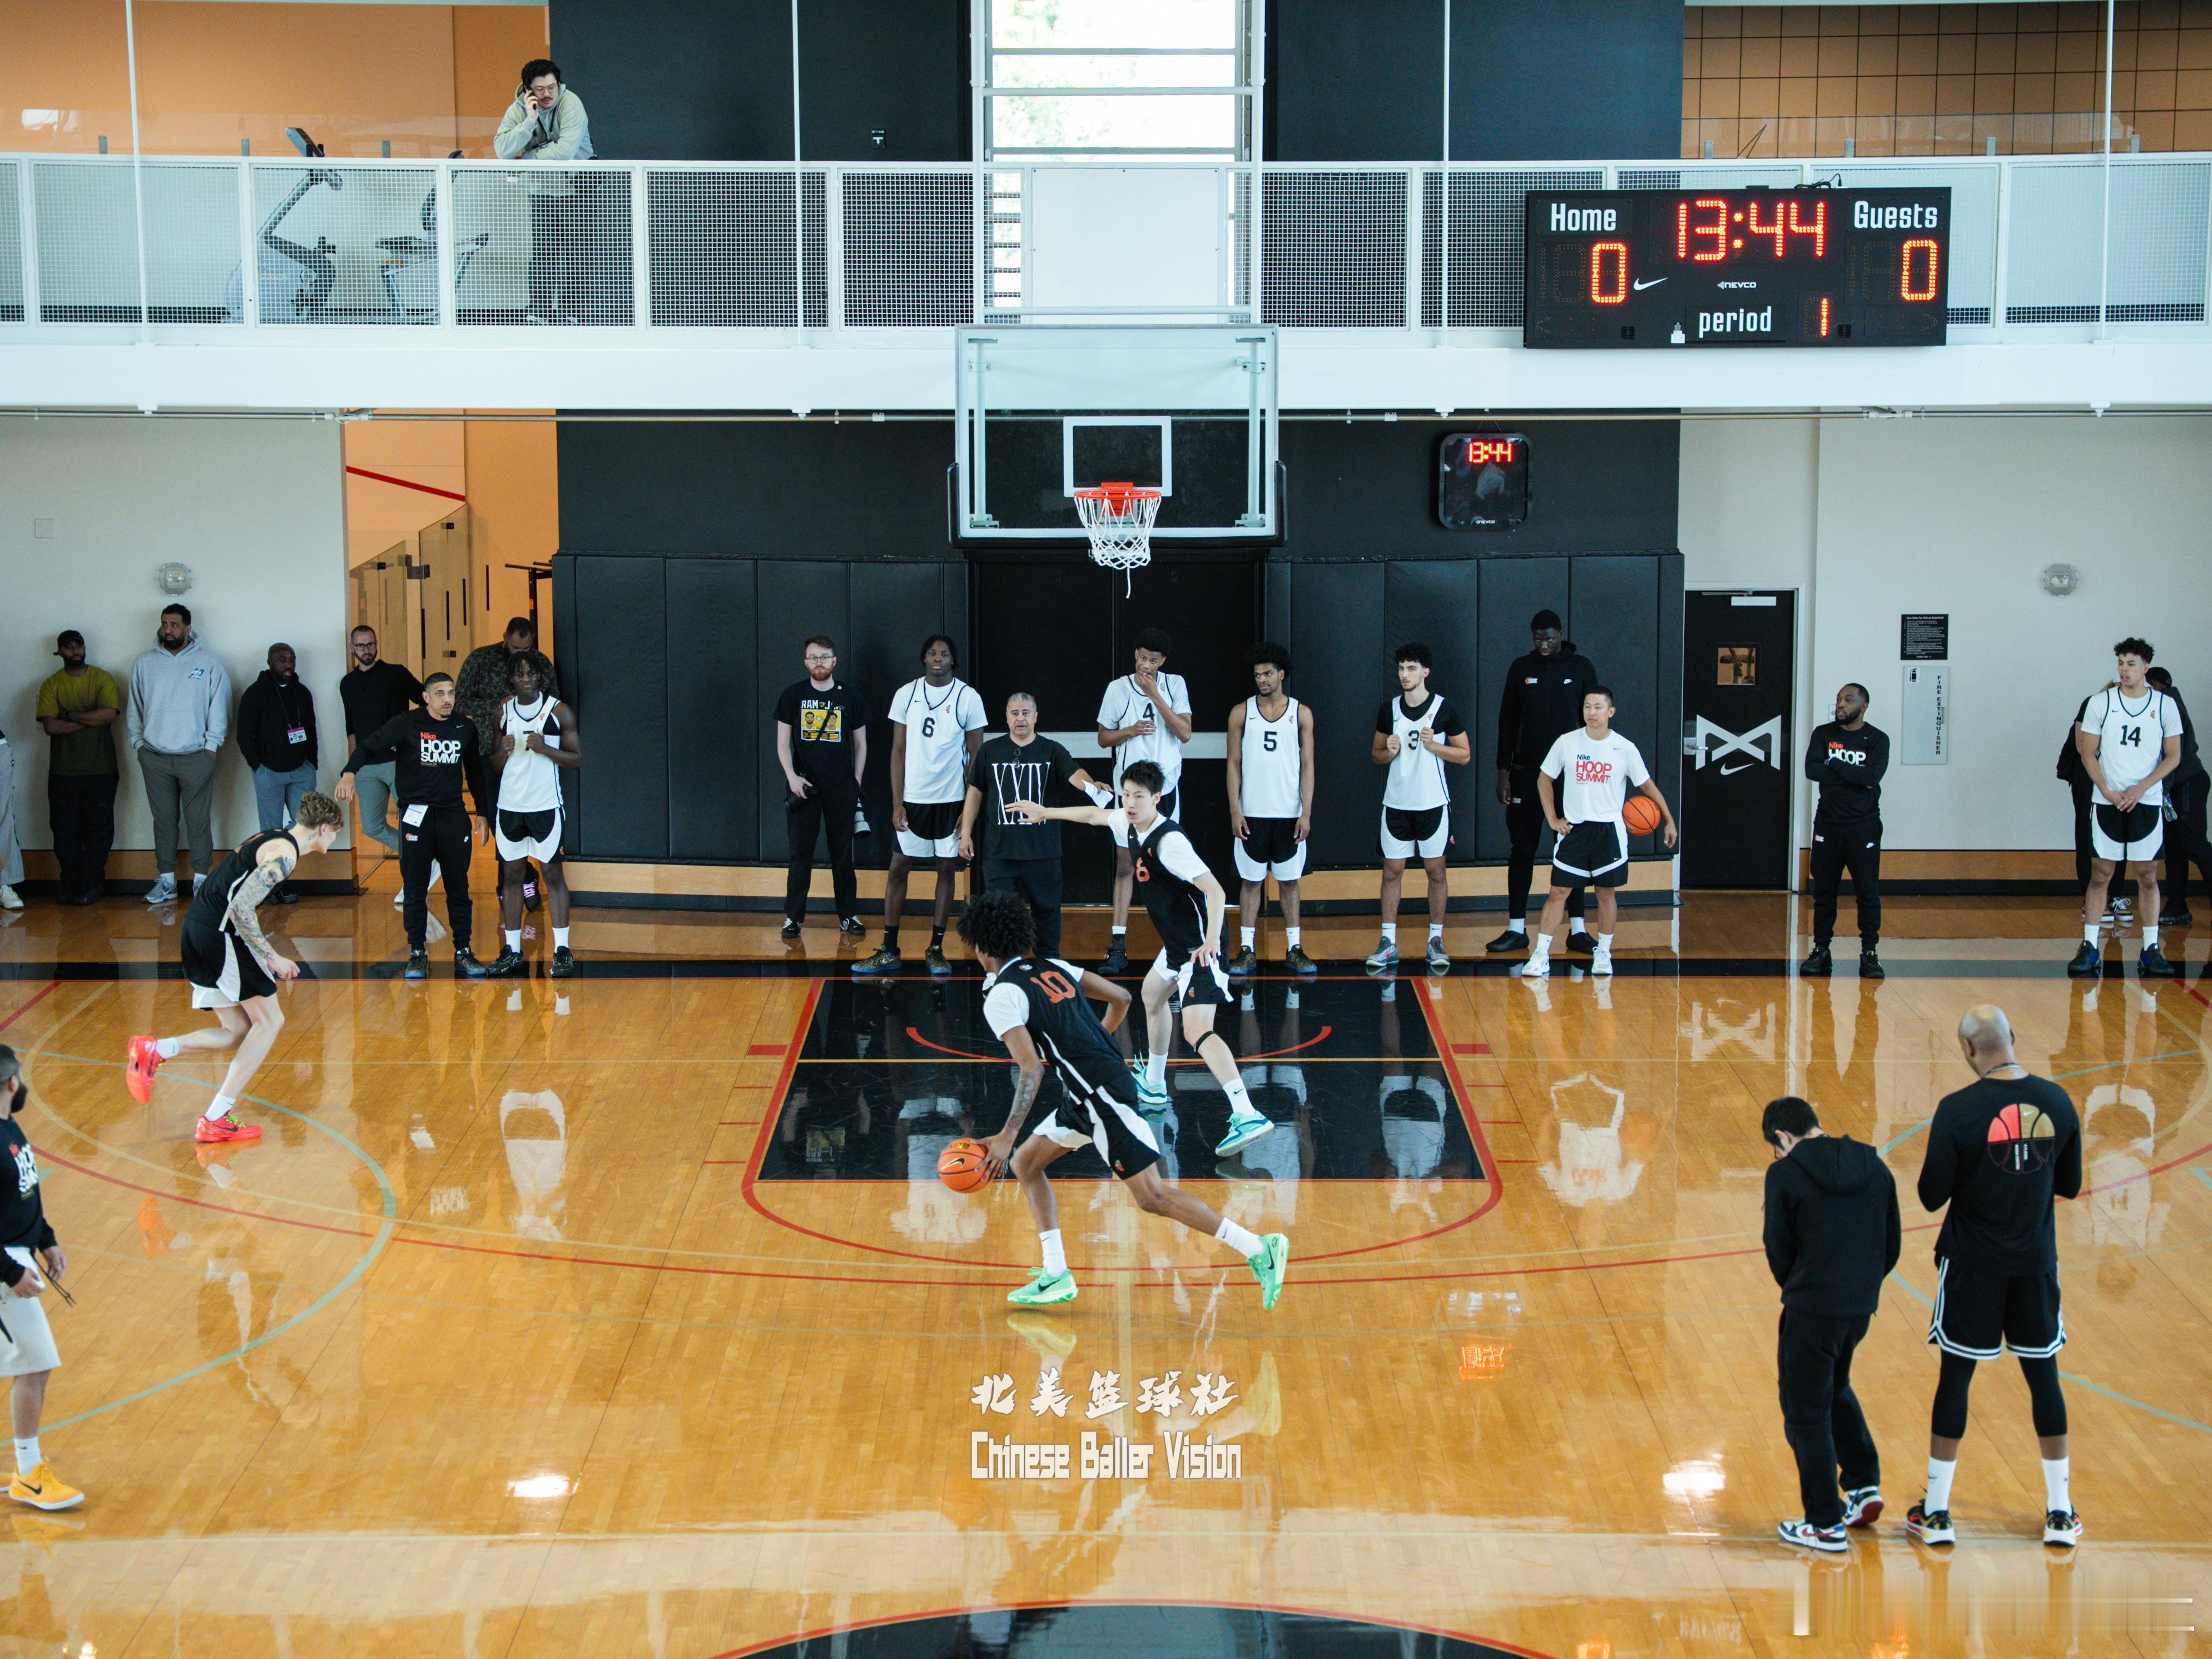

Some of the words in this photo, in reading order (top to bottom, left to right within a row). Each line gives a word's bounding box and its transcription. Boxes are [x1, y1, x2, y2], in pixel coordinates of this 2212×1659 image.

[1551, 203, 1616, 231] Home
[1854, 201, 1938, 229] Guests
[1677, 198, 1827, 262] 13:44
[1591, 241, 1627, 304] 0
[1901, 239, 1938, 301] 0
[1699, 306, 1772, 338] period
[1819, 297, 1829, 337] 1
[1469, 442, 1512, 463] 13:44
[801, 700, 819, 709] RAM
[1143, 703, 1155, 722] 4
[922, 717, 935, 738] 6
[2120, 724, 2141, 747] 14
[420, 739, 461, 754] HOOP
[1263, 731, 1277, 752] 5
[1408, 729, 1420, 751] 3
[420, 752, 460, 764] SUMMIT
[1576, 761, 1612, 774] HOOP
[1828, 748, 1866, 766] HOOP
[1576, 772, 1611, 784] SUMMIT
[991, 762, 1051, 826] XXIV
[1136, 857, 1150, 882] 6
[1030, 971, 1076, 1004] 10
